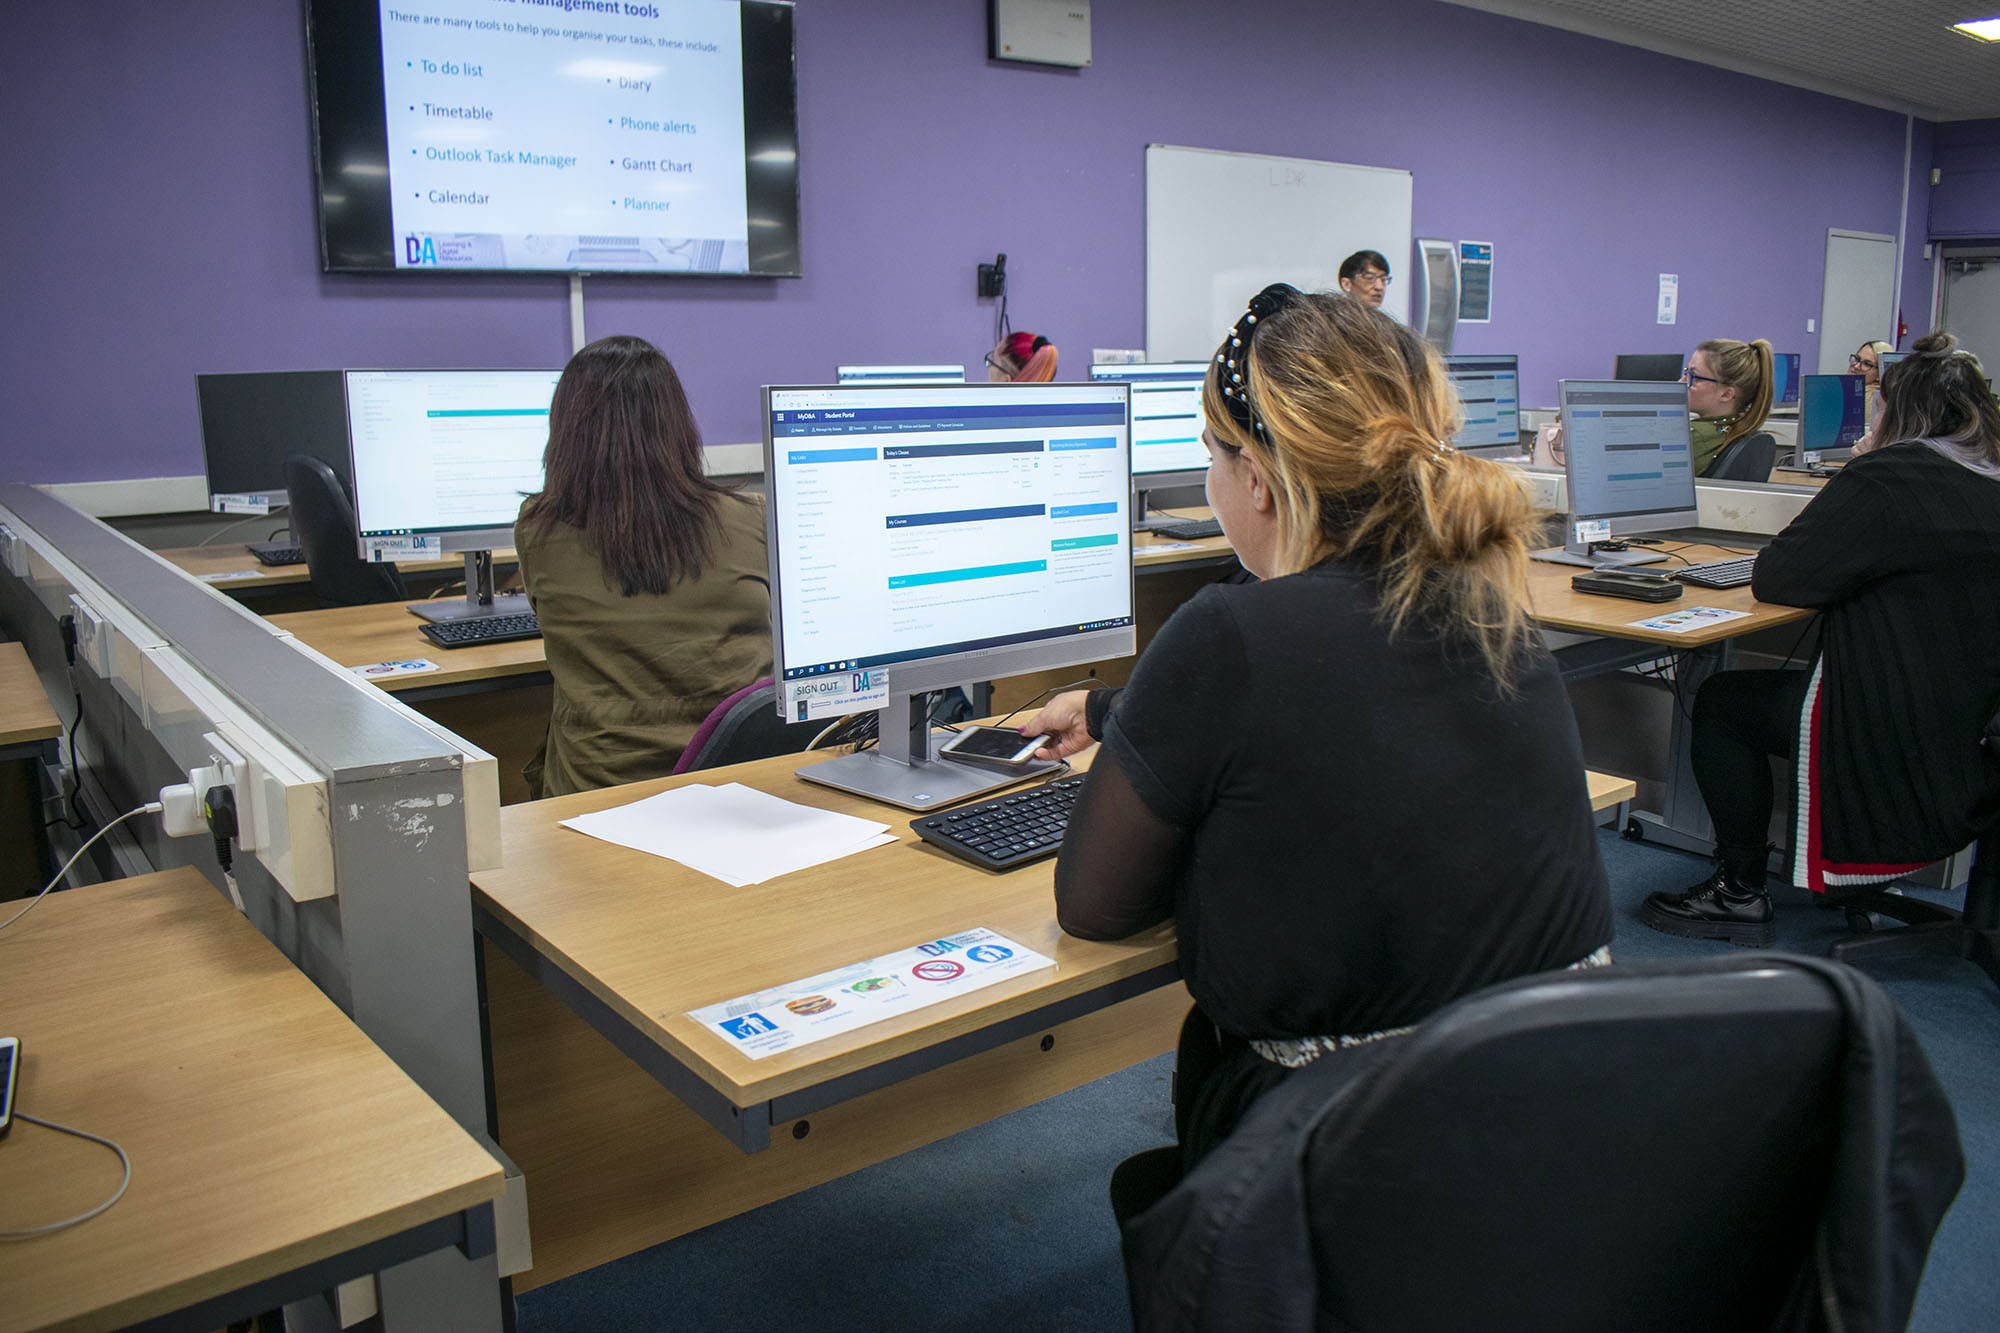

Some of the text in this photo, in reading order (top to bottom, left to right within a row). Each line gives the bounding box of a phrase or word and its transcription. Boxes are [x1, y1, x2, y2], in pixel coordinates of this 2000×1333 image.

[624, 3, 659, 18] tools
[388, 10, 420, 24] There
[423, 14, 440, 25] are
[443, 17, 473, 29] many
[475, 19, 500, 31] tools
[503, 22, 514, 32] to
[516, 23, 539, 36] help
[541, 26, 560, 37] you
[562, 27, 602, 41] organise
[606, 33, 627, 43] your
[630, 35, 656, 47] tasks,
[658, 36, 683, 49] these
[421, 59, 483, 77] To do list
[619, 77, 652, 93] Diary
[424, 103, 493, 121] Timetable
[620, 116, 697, 135] Phone alerts
[426, 147, 577, 169] Outlook Task Manager
[622, 157, 693, 173] Gantt Chart
[428, 190, 490, 206] Calendar
[624, 196, 671, 211] Planner
[796, 681, 839, 696] SIGN OUT
